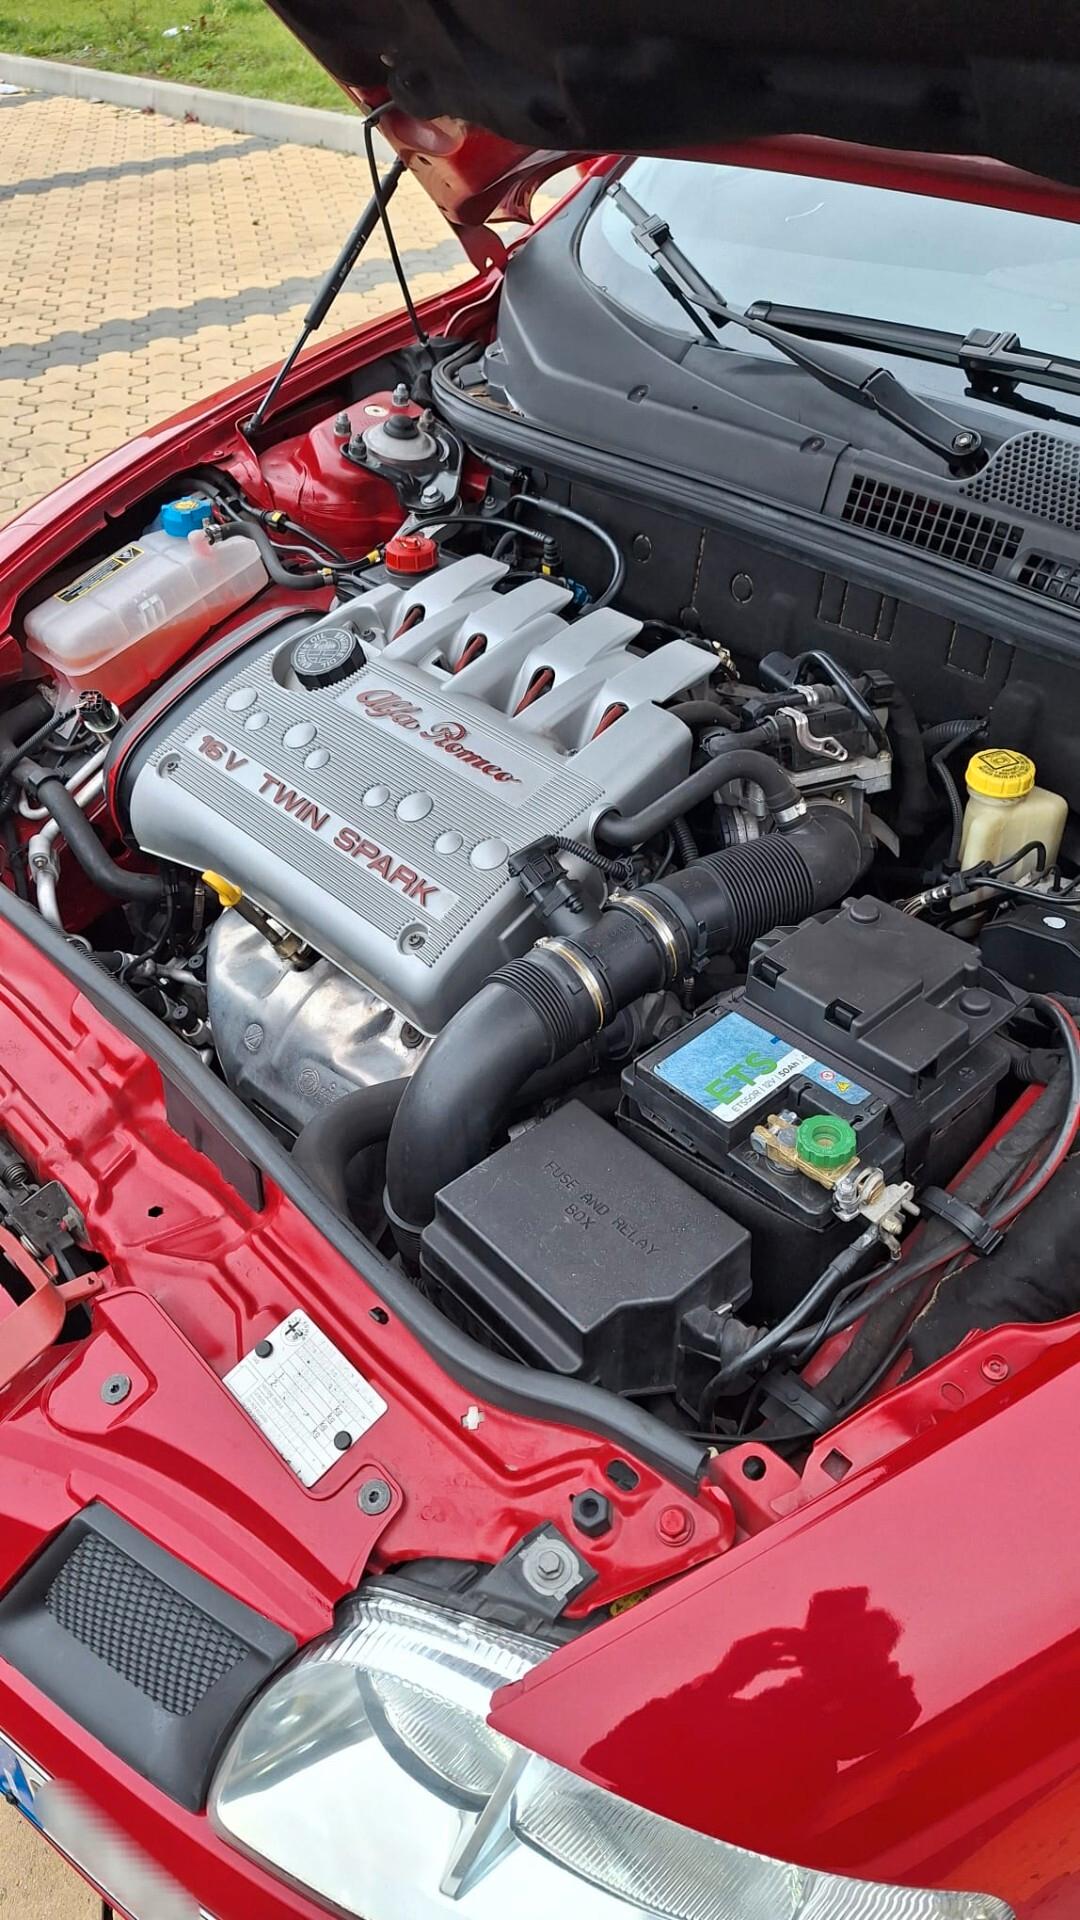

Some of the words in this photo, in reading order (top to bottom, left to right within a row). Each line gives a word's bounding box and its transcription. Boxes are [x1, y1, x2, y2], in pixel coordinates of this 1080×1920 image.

[356, 689, 423, 730] Alfa
[420, 721, 522, 783] Romeo
[198, 734, 249, 772] 16V
[258, 772, 331, 832] TWIN
[333, 827, 440, 907] SPARK
[704, 1052, 777, 1105] ETS
[778, 1062, 800, 1077] 50Ah
[544, 1161, 580, 1189] FUSE
[580, 1193, 610, 1216] AND
[612, 1216, 660, 1255] RELAY
[564, 1203, 597, 1230] BOX
